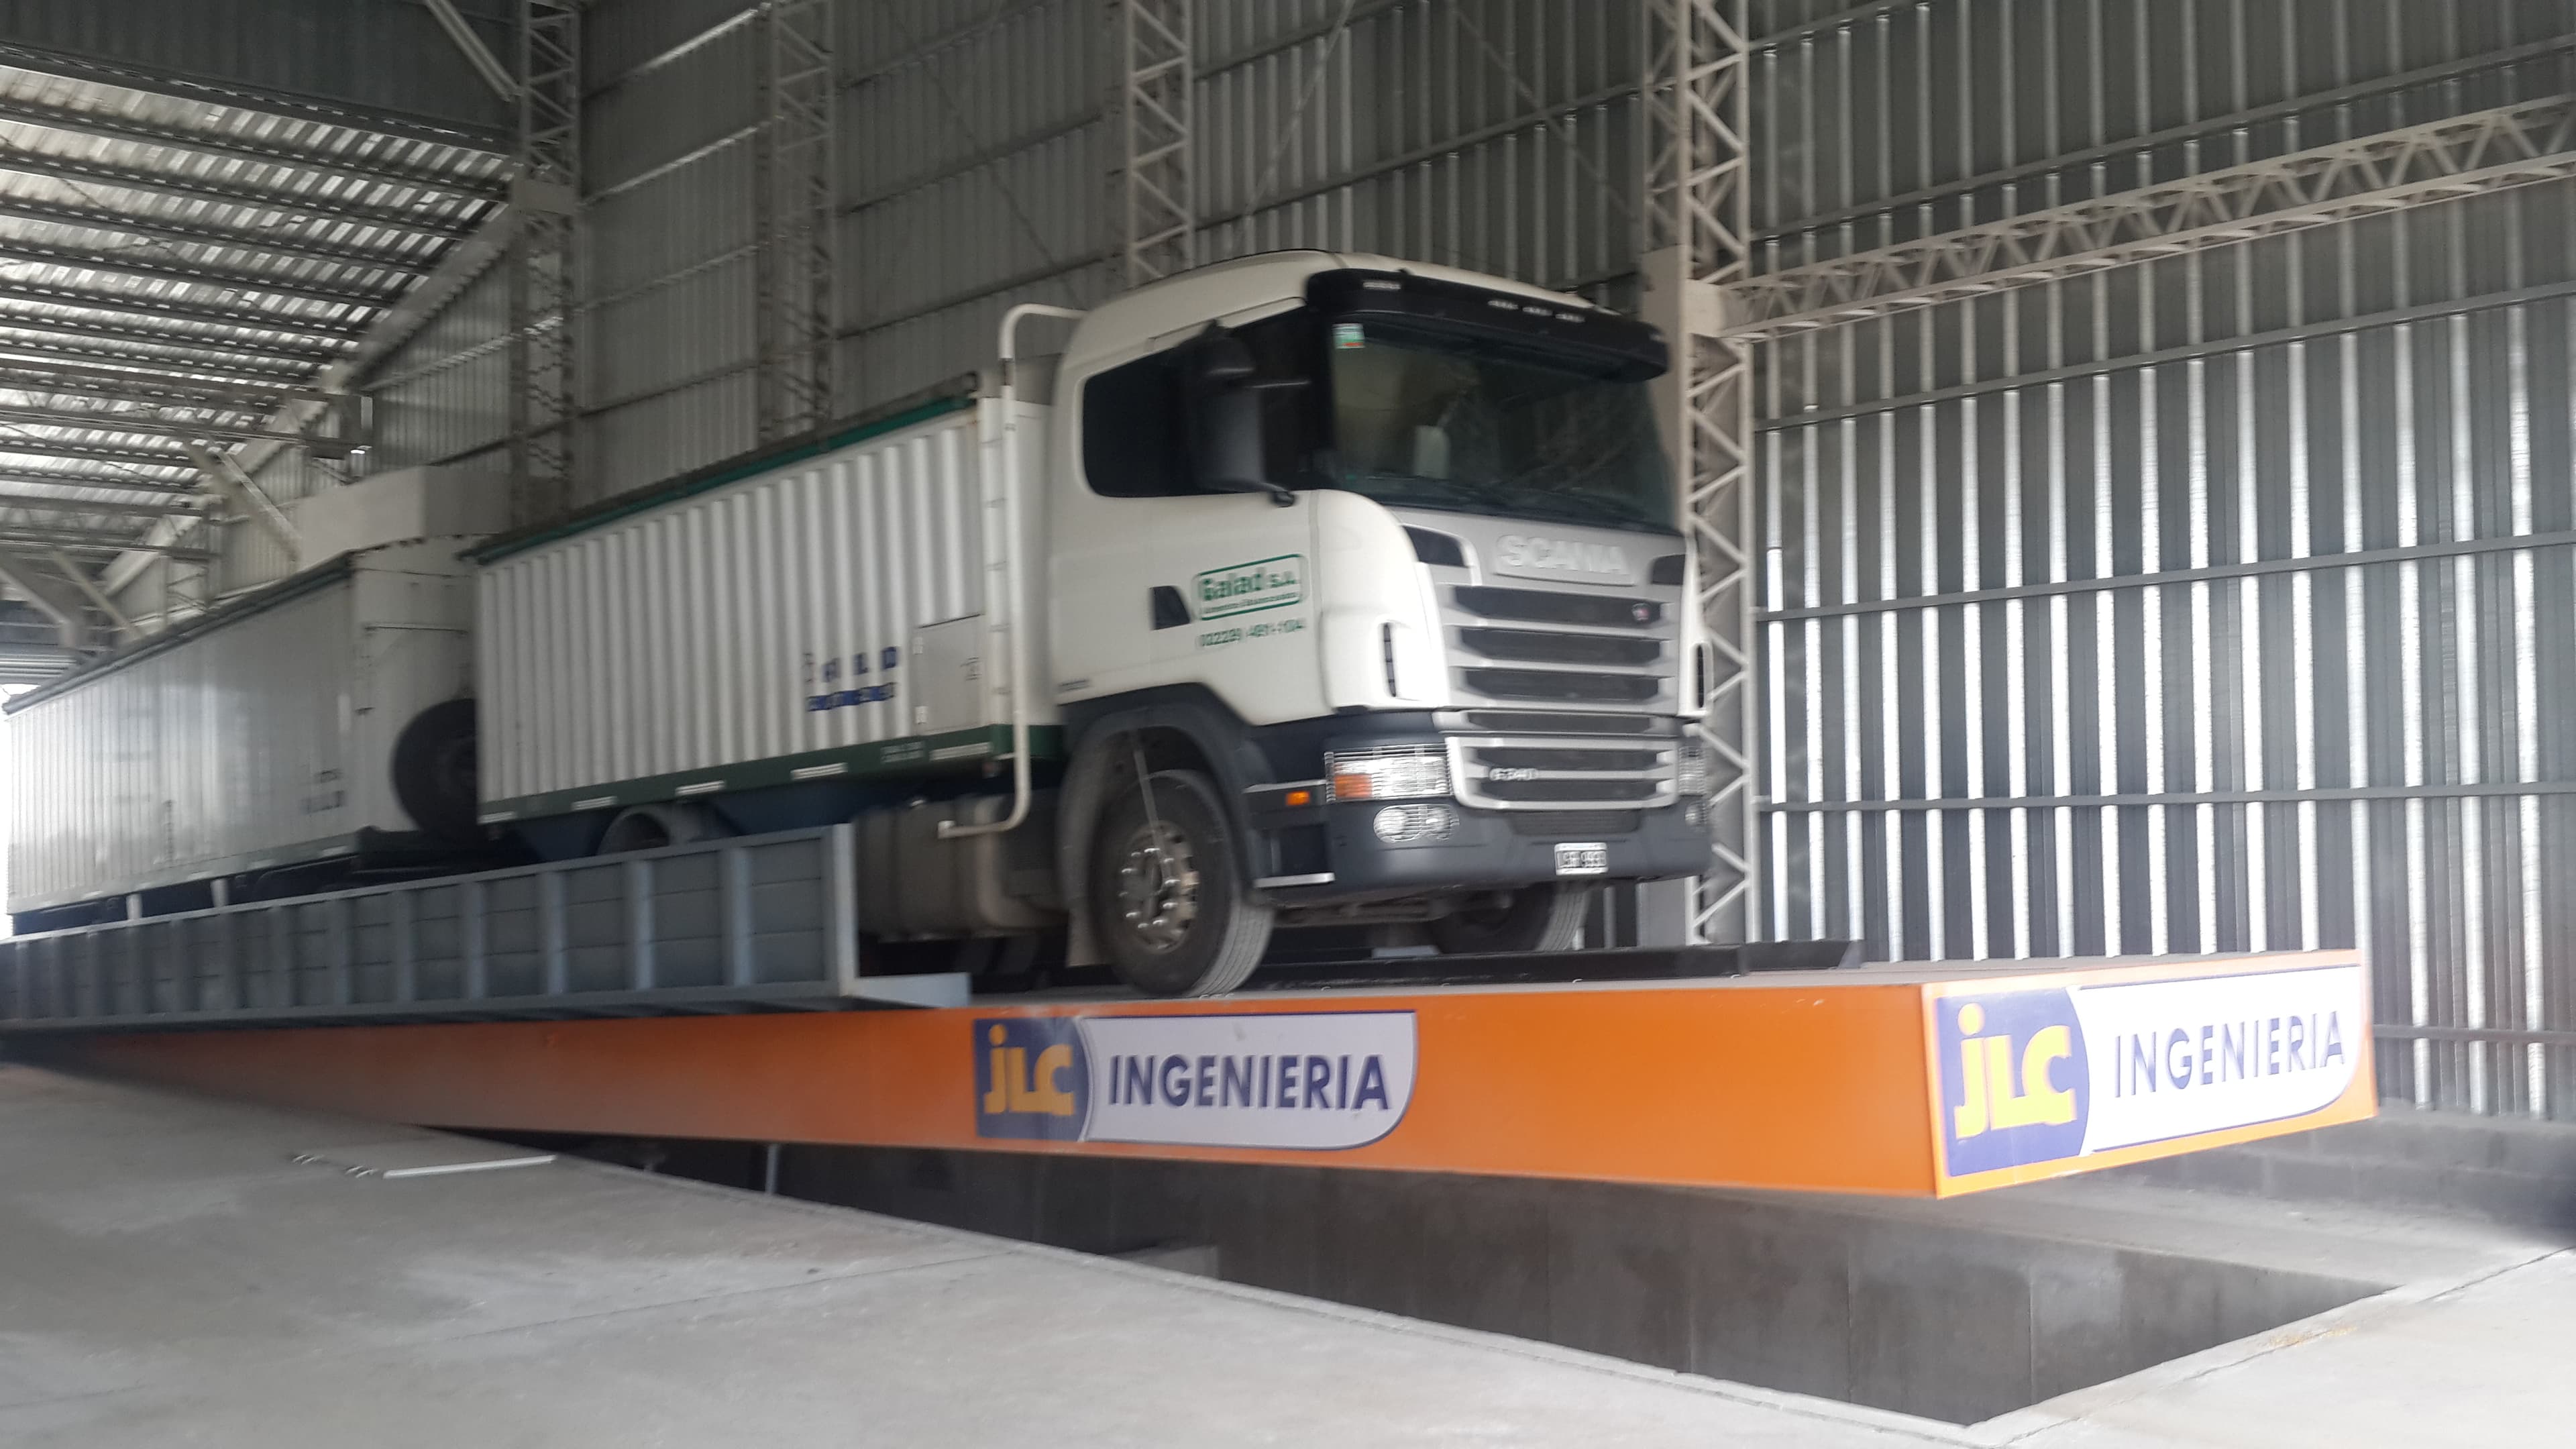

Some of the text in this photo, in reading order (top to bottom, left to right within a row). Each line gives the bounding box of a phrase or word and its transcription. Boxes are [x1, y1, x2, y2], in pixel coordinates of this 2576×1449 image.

[1497, 535, 1630, 575] SCANIA
[2114, 1010, 2345, 1097] INGENIERIA
[1108, 1054, 1392, 1111] INGENIERIA
